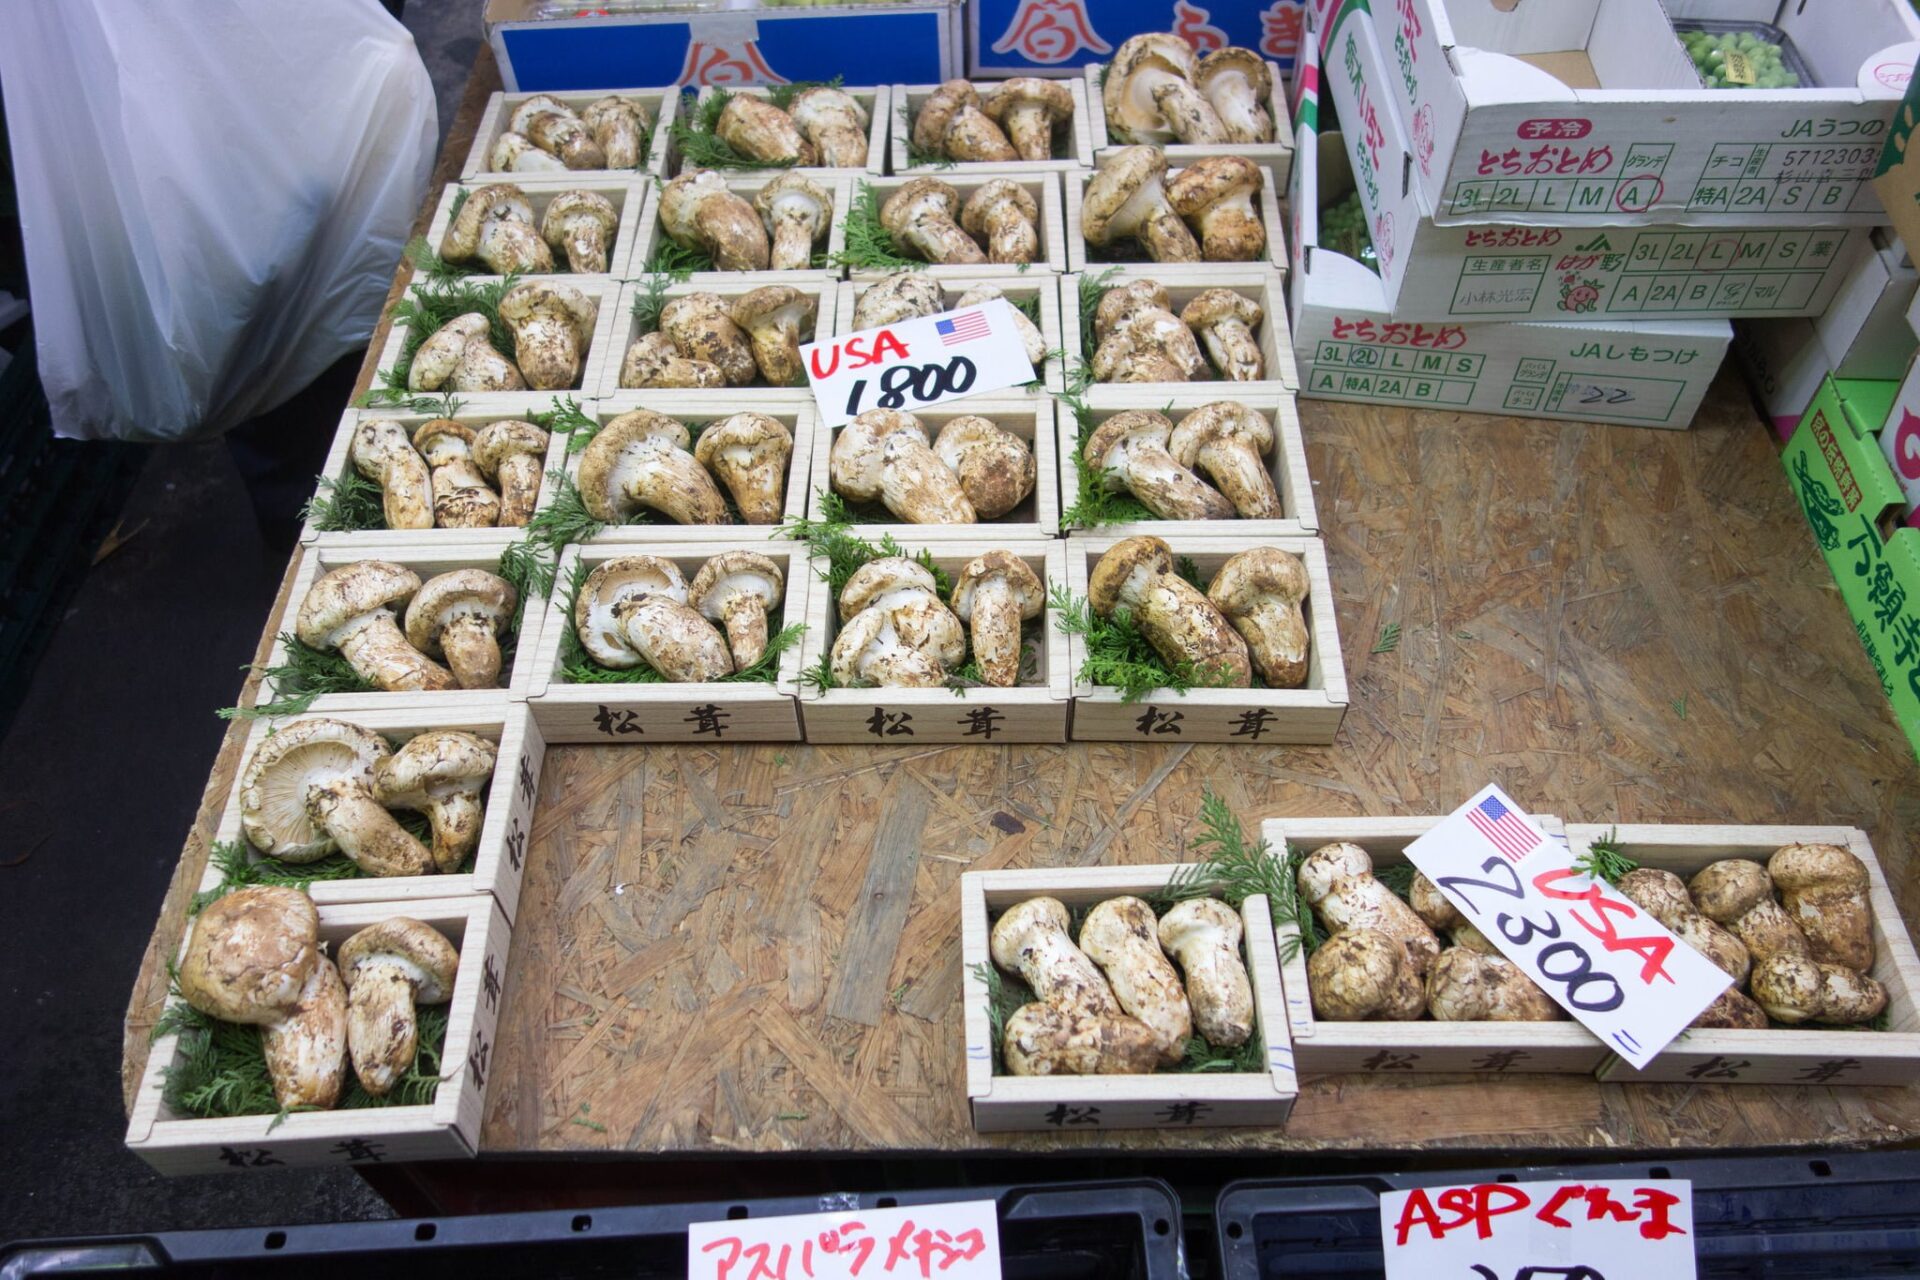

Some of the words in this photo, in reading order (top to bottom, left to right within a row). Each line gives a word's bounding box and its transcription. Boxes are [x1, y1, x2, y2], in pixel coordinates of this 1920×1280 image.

[1526, 121, 1583, 138] 予冷
[1477, 144, 1614, 175] とちおとめ
[1626, 153, 1668, 169] グランデ
[1711, 155, 1744, 168] チコ
[1459, 188, 1483, 208] 3L
[1499, 187, 1523, 206] 2L
[1543, 187, 1556, 205] L
[1578, 186, 1604, 206] M
[1617, 187, 1638, 206] A
[1694, 186, 1728, 206] 特A
[1734, 187, 1765, 206] 2A
[1783, 187, 1803, 206] S
[1822, 186, 1842, 205] B
[1464, 228, 1562, 247] とちおとめ
[1635, 244, 1660, 261] 3L
[1670, 243, 1695, 260] 2L
[1710, 244, 1723, 259] L
[1741, 243, 1766, 259] M
[1779, 242, 1797, 259] S
[1471, 258, 1543, 272] 生産者名
[1622, 286, 1638, 301] A
[1650, 285, 1676, 301] 2A
[1690, 285, 1707, 300] B
[1331, 316, 1468, 349] とちおとめ
[811, 329, 910, 380] USA
[1322, 346, 1343, 362] 3L
[1355, 350, 1377, 365] 2L
[1391, 353, 1404, 367] L
[1422, 355, 1442, 371] M
[1456, 358, 1473, 373] S
[1569, 342, 1699, 365] JAしもつけ
[846, 355, 977, 416] 1800
[1319, 374, 1334, 389] A
[1379, 380, 1401, 395] 2A
[1415, 383, 1432, 397] B
[593, 703, 731, 737] 松茸
[865, 706, 1006, 739] 松茸
[1135, 705, 1279, 740] 松茸
[1532, 867, 1676, 985] USA
[1045, 1101, 1214, 1126] 松茸
[219, 1137, 388, 1168] 松茸
[1394, 1183, 1531, 1246] ASP
